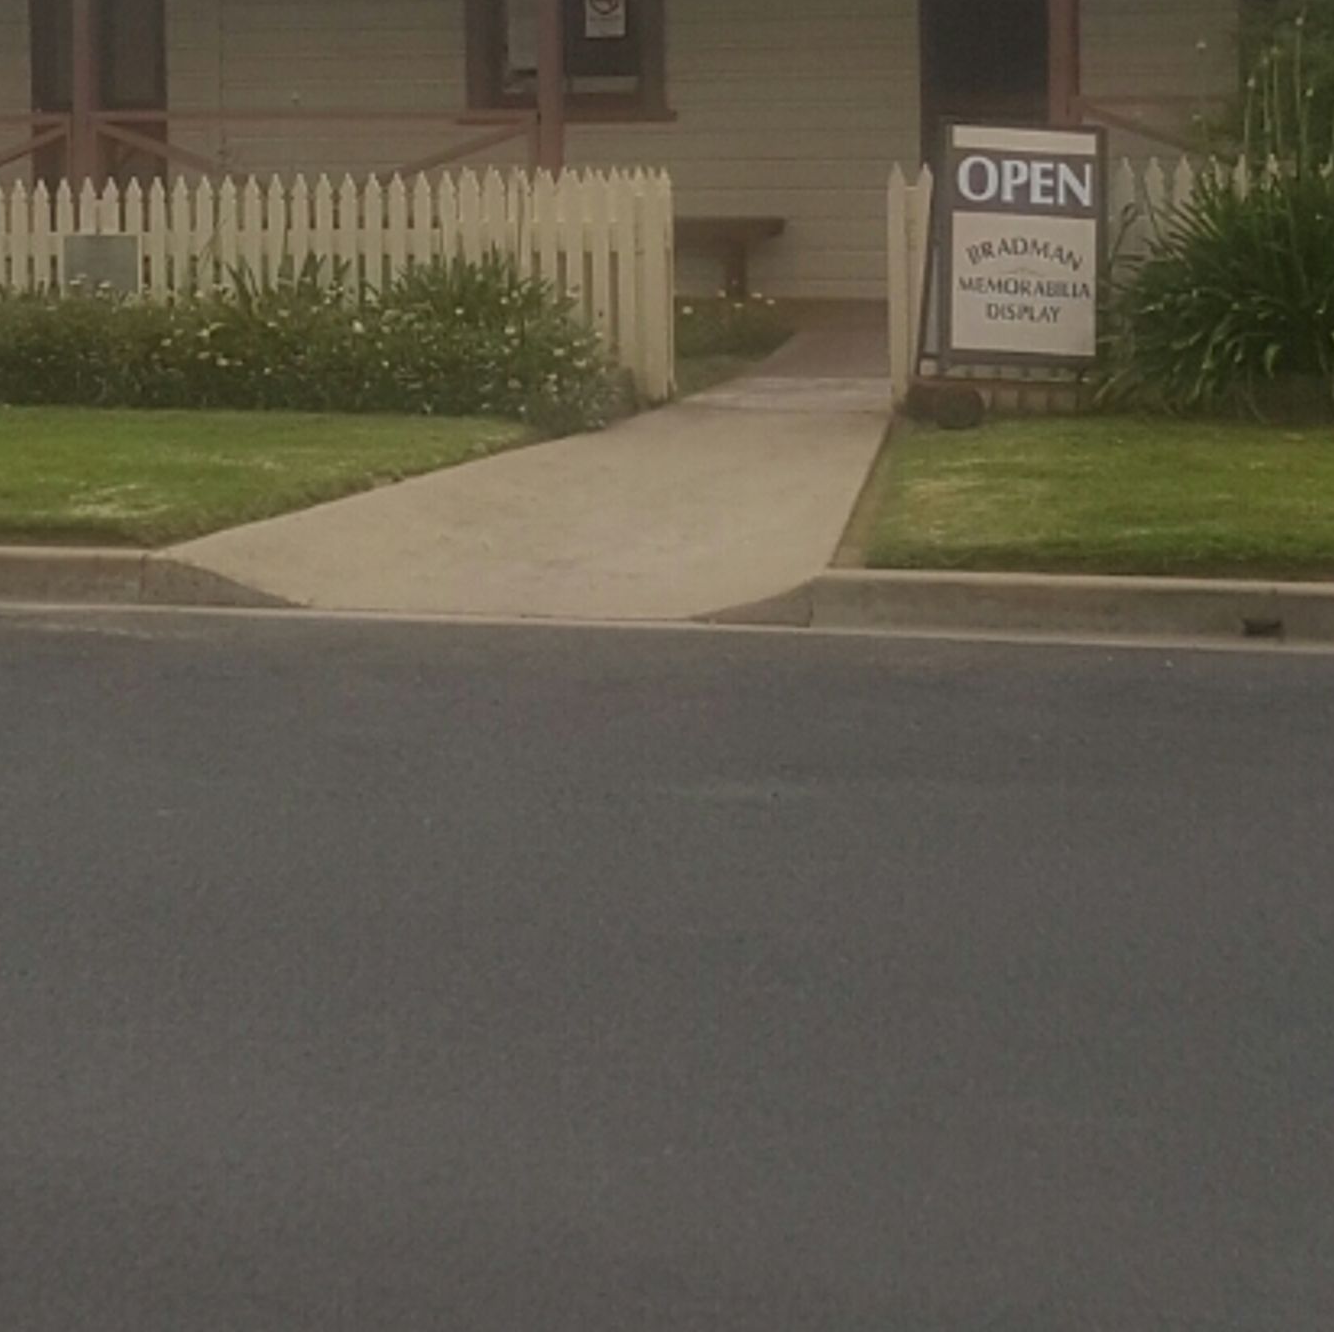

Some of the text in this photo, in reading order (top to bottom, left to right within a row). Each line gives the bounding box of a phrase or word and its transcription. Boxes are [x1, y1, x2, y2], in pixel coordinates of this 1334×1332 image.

[957, 155, 1093, 207] OPEN
[965, 236, 1083, 272] BRADMAN
[958, 276, 1091, 300] MEMORABILIA
[986, 303, 1062, 323] DISPLAY
